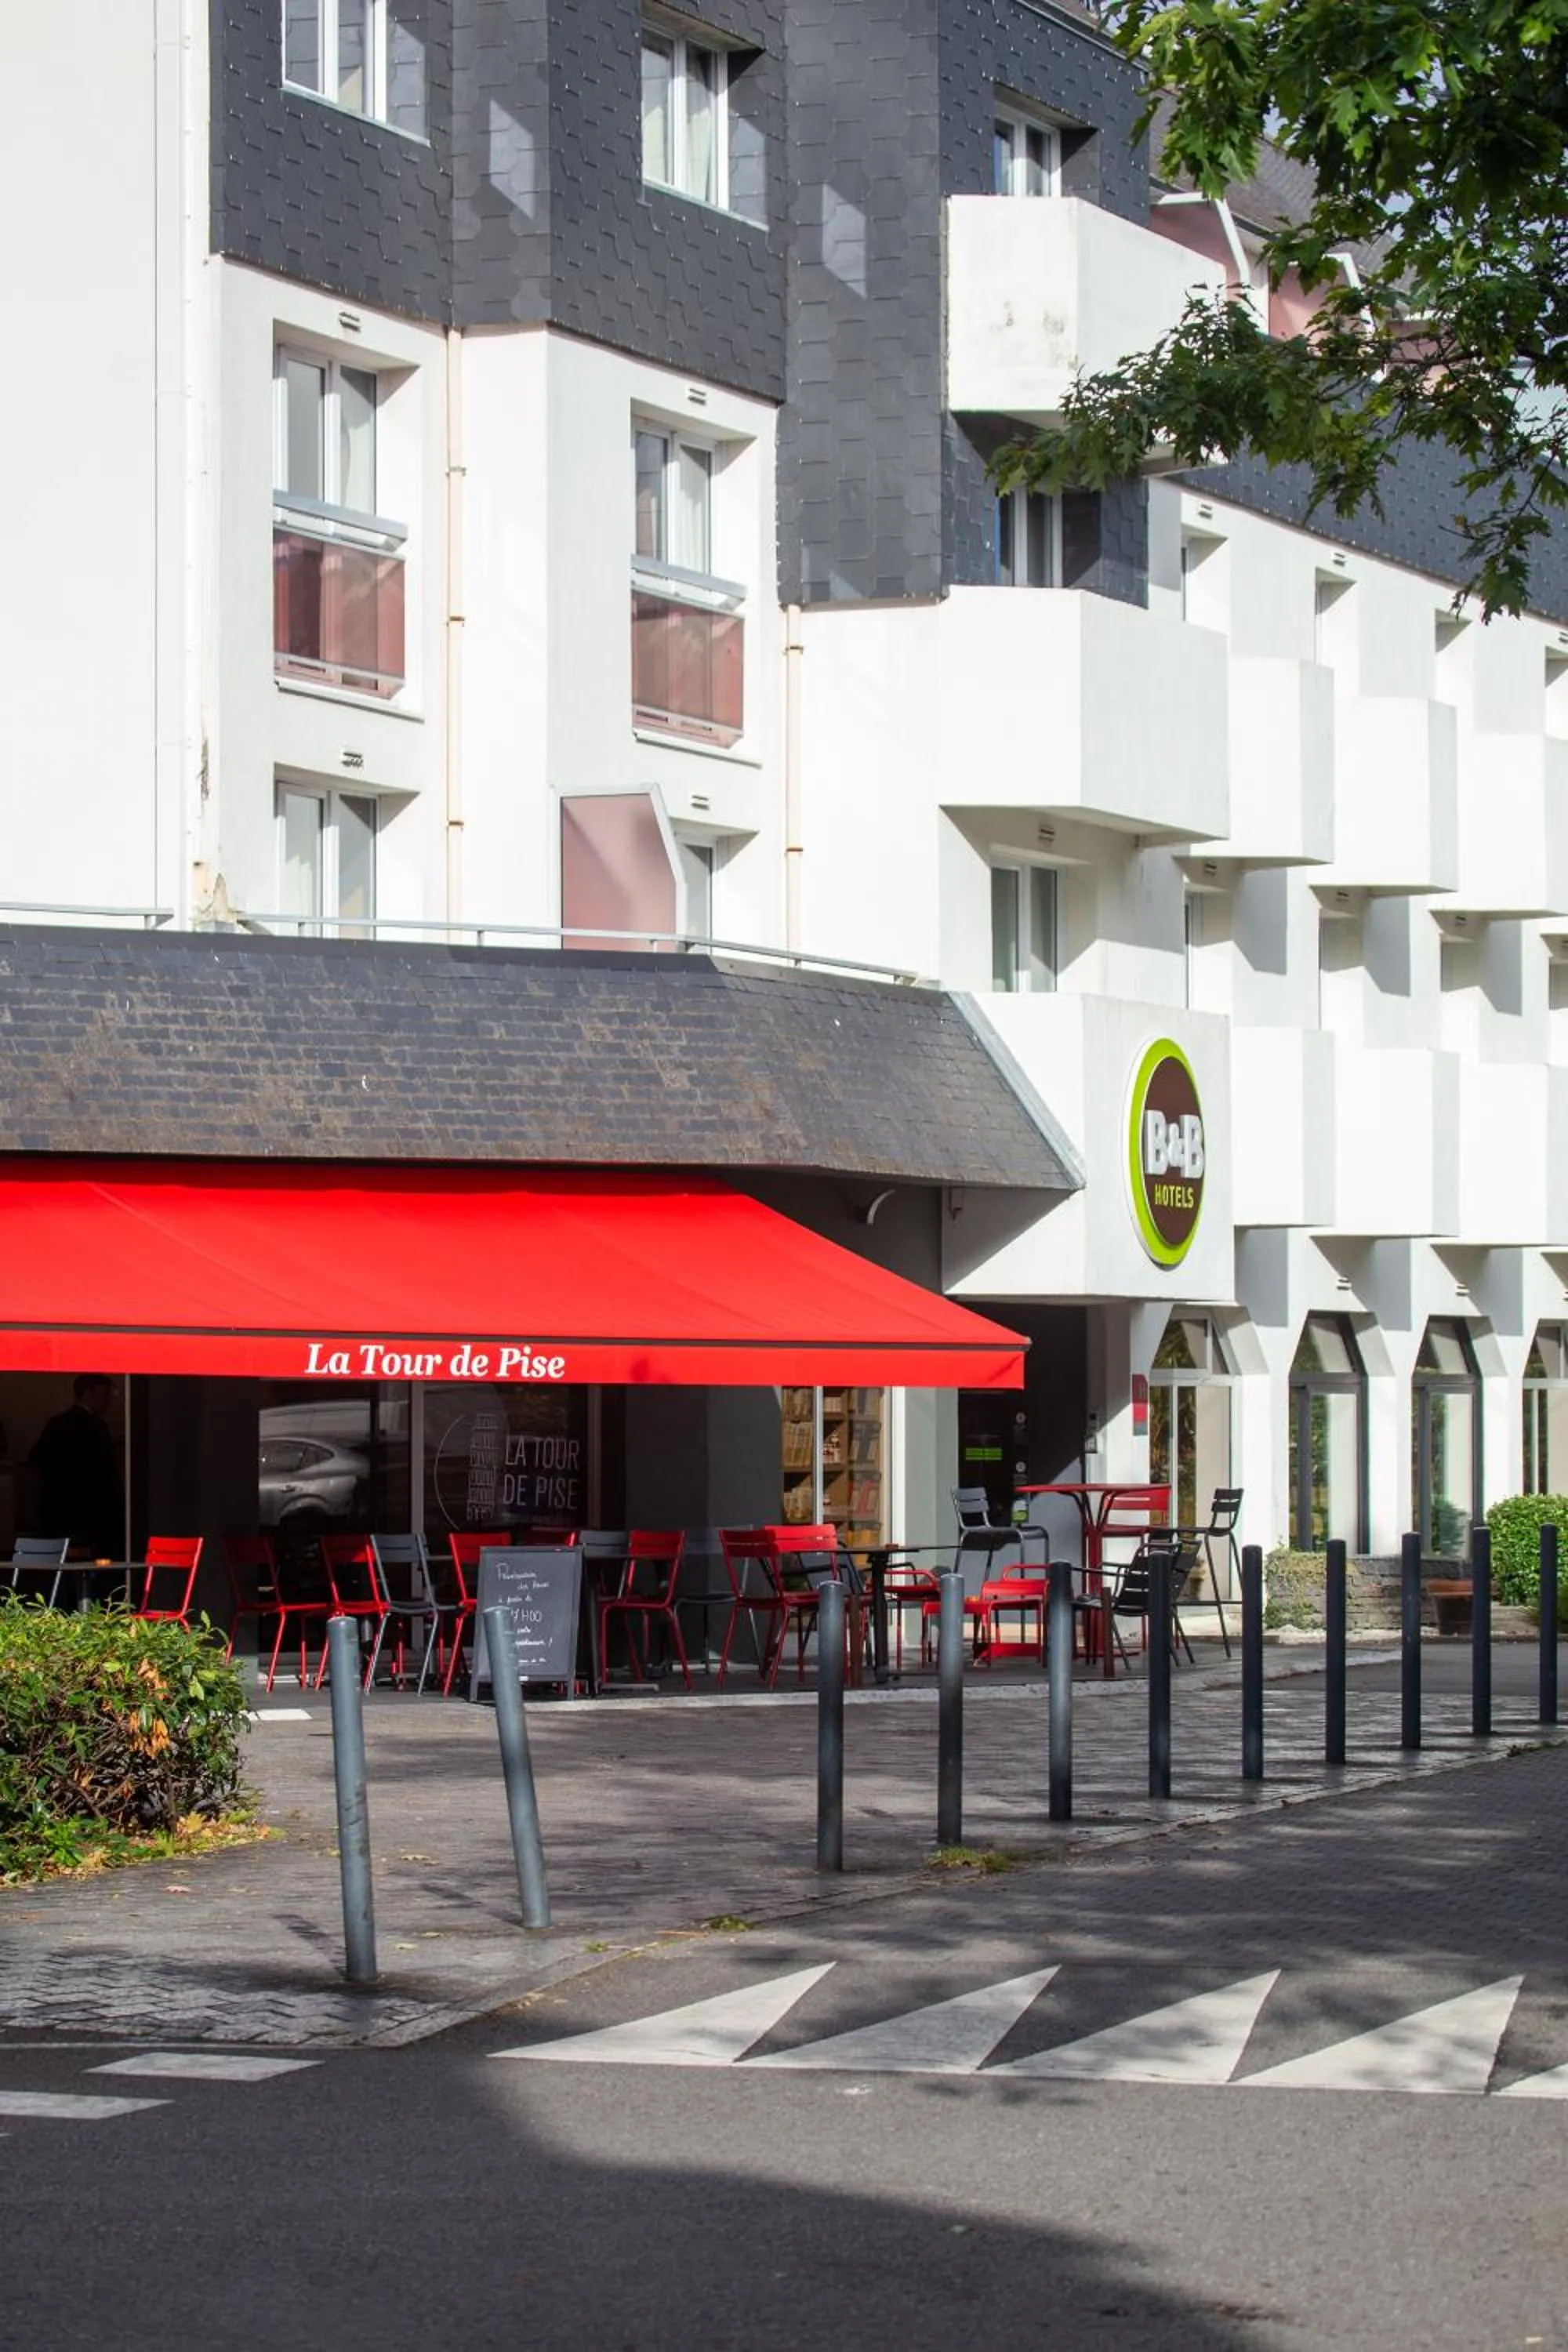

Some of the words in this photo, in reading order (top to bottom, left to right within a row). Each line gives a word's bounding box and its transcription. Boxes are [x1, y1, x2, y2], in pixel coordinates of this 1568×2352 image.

[1144, 1109, 1203, 1179] B&B
[1155, 1183, 1194, 1208] HOTELS
[304, 1343, 350, 1375] La
[359, 1344, 442, 1376] Tour
[449, 1345, 488, 1377] de
[495, 1345, 565, 1378] Pise
[505, 1434, 526, 1468] LA
[533, 1436, 579, 1471] TOUR
[503, 1473, 527, 1506] DE
[535, 1475, 578, 1509] PISE
